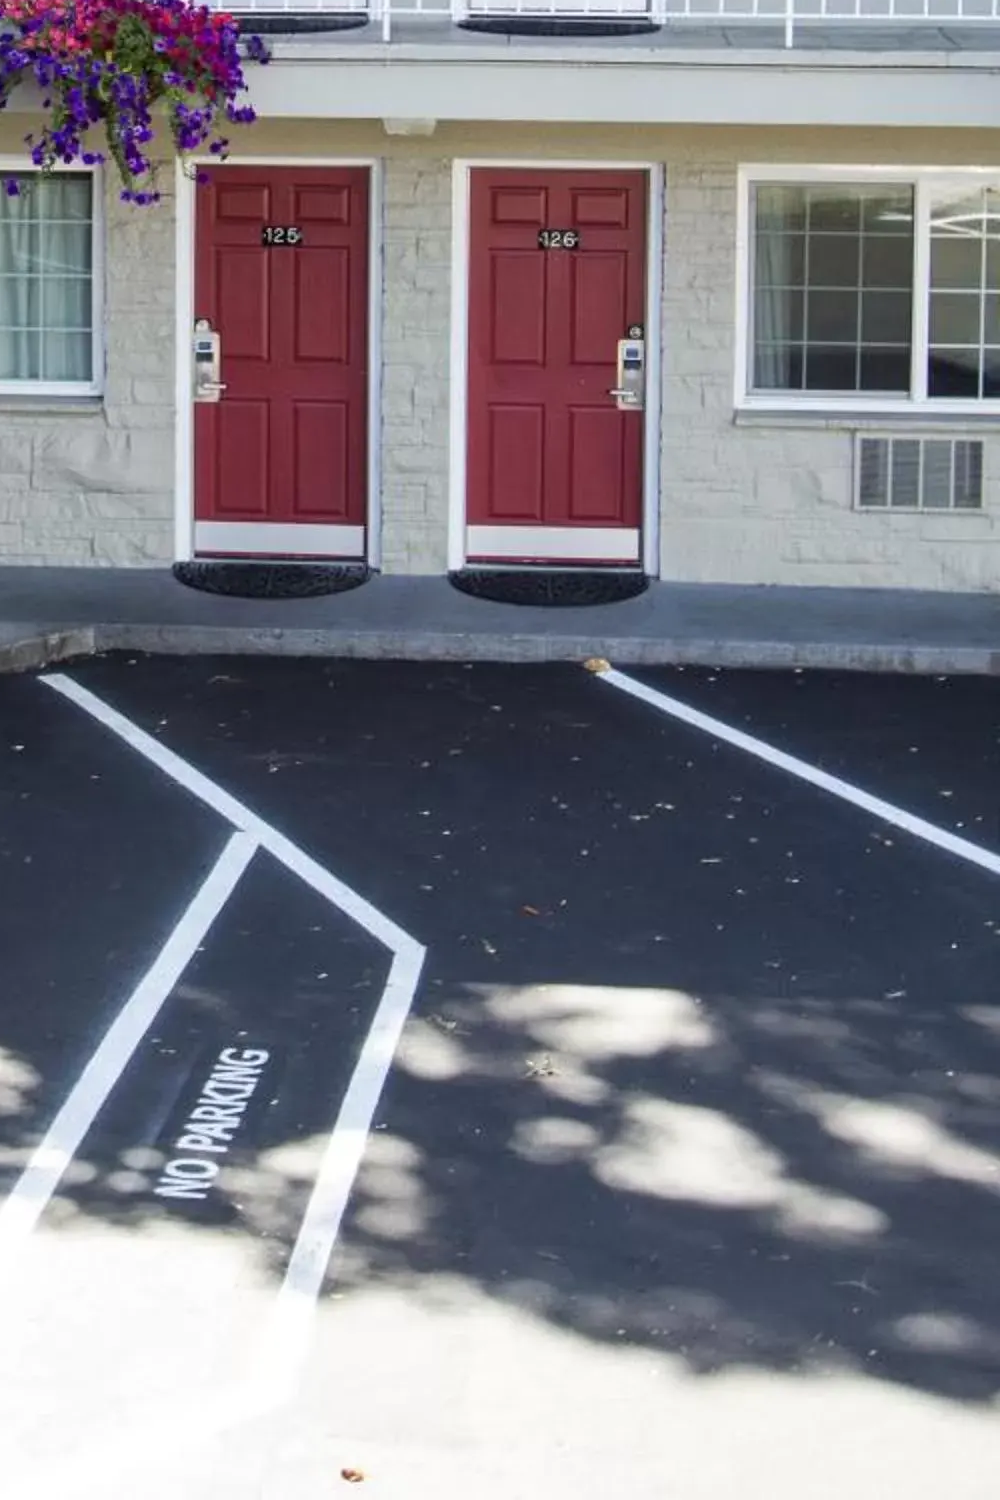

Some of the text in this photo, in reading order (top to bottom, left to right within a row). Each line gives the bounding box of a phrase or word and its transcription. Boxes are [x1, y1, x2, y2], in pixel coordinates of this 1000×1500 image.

[265, 227, 299, 244] 125
[541, 231, 576, 248] 126
[153, 1047, 270, 1199] NO PARKING
